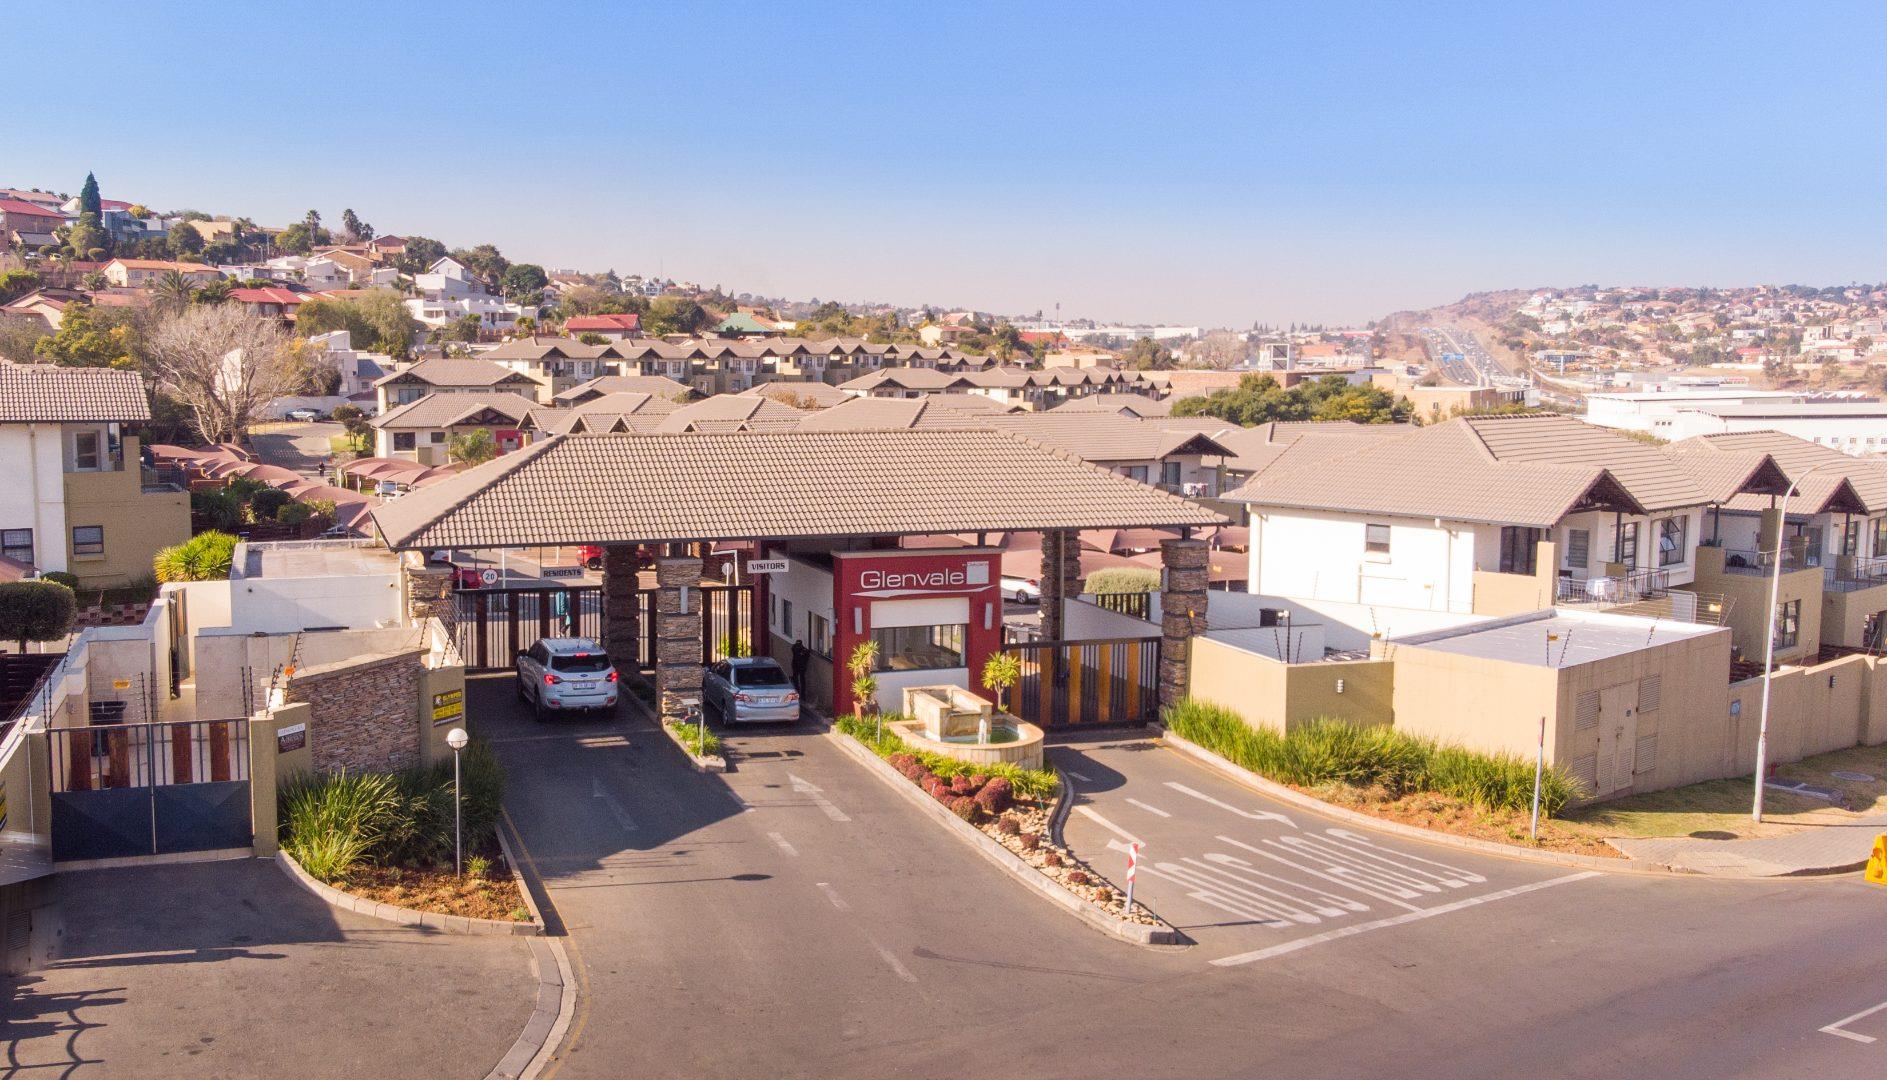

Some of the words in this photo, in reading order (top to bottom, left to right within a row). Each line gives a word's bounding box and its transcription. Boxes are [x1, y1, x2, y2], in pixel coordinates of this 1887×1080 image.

[543, 569, 582, 578] RESIDENTS
[751, 562, 785, 570] VISITORS
[861, 568, 964, 589] Glenvale
[1261, 828, 1487, 899] STOP
[1137, 853, 1371, 929] STOP
